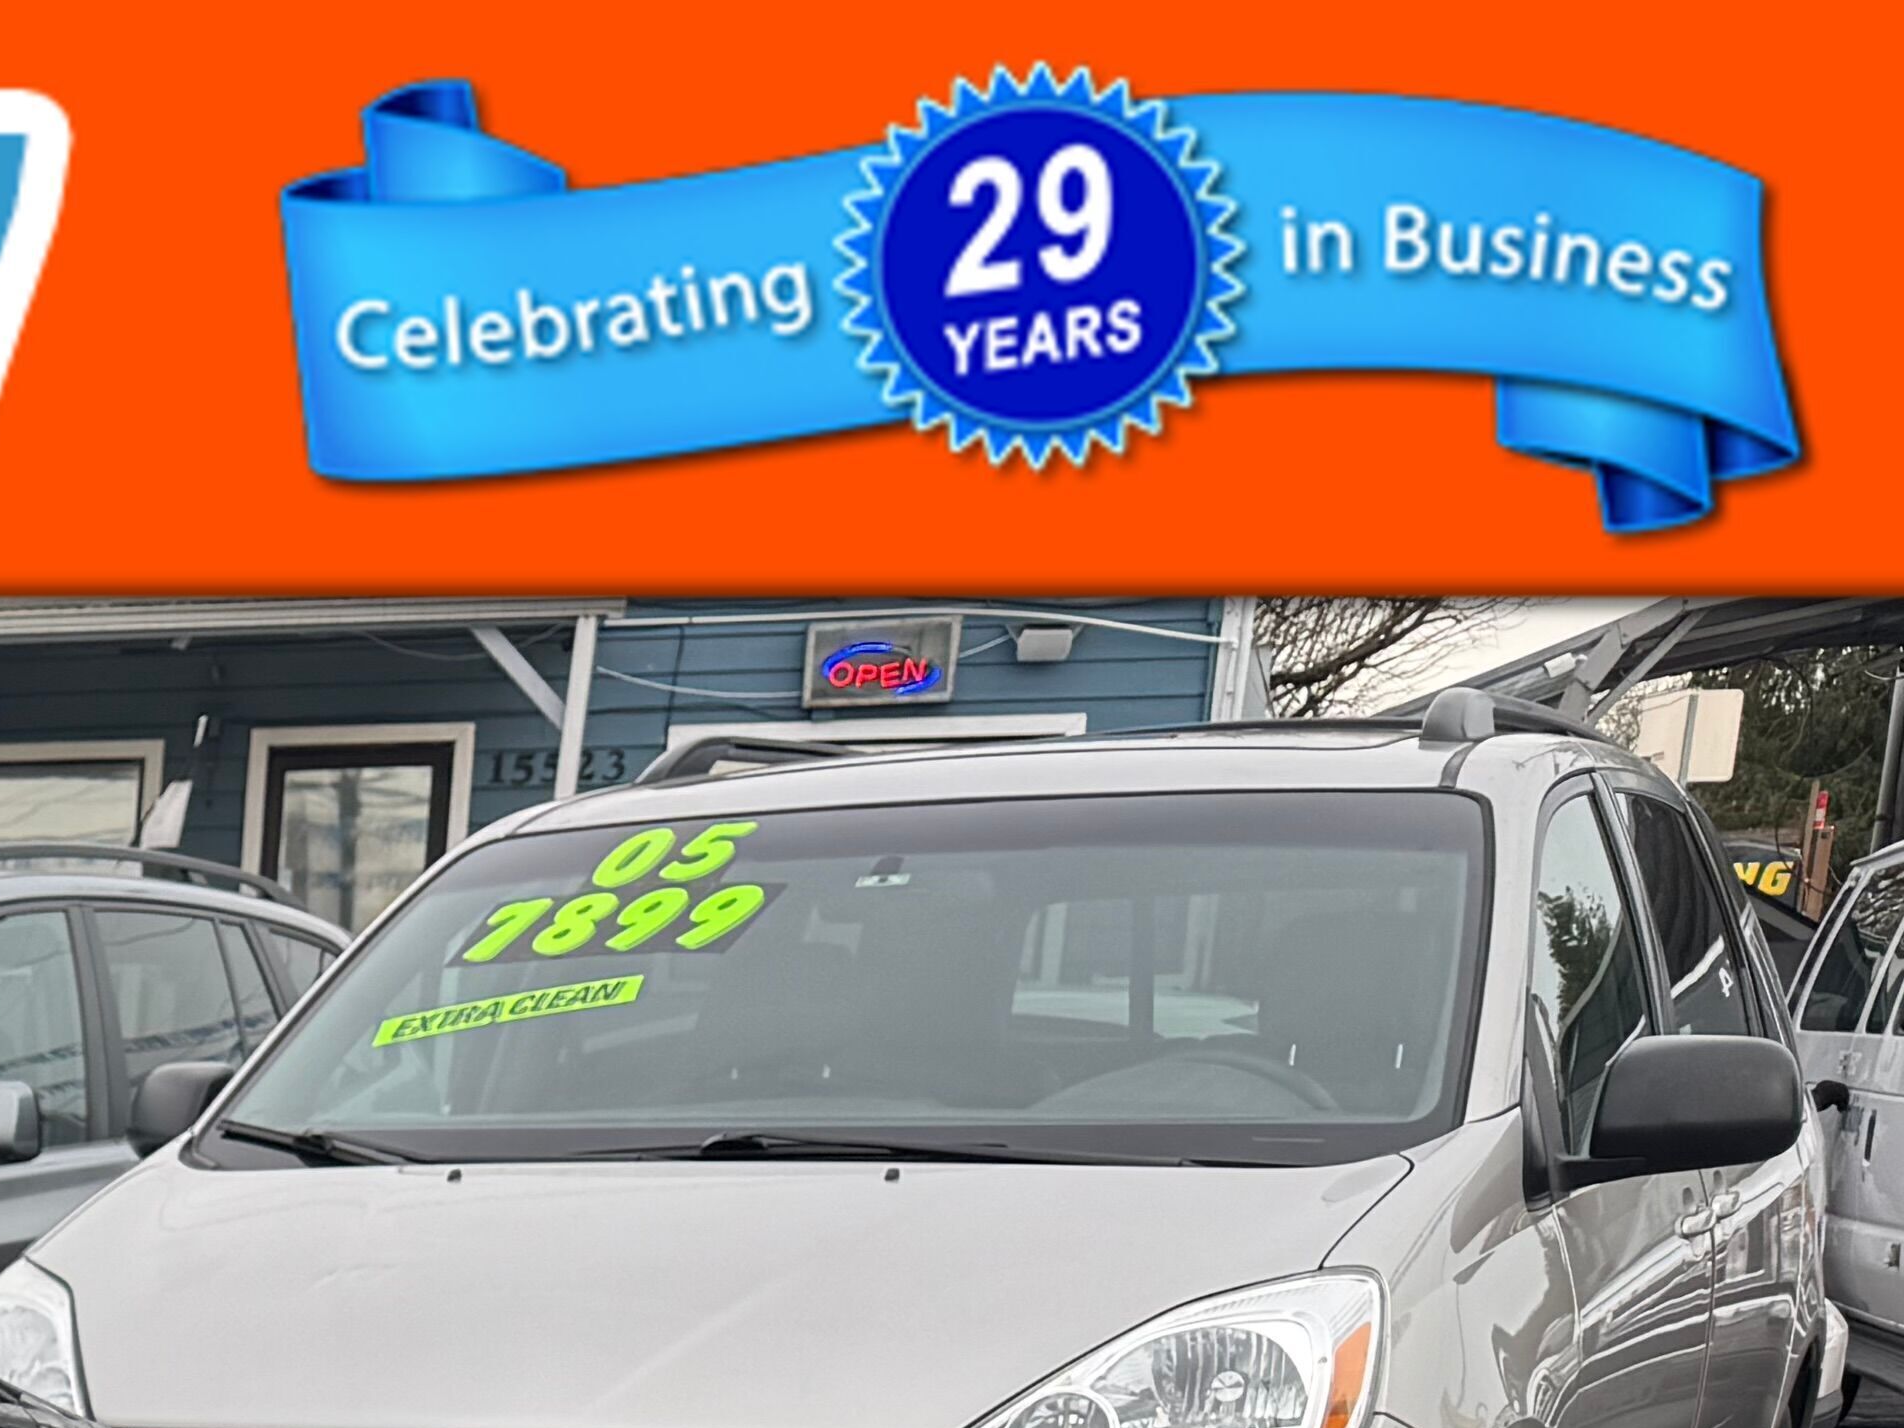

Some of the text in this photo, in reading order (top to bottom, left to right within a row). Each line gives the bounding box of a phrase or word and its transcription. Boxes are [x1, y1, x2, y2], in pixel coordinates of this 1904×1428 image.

[828, 657, 928, 689] OPEN
[592, 820, 760, 889] 05
[461, 883, 766, 963] 7899
[392, 980, 627, 1038] EXTRA CLEAN
